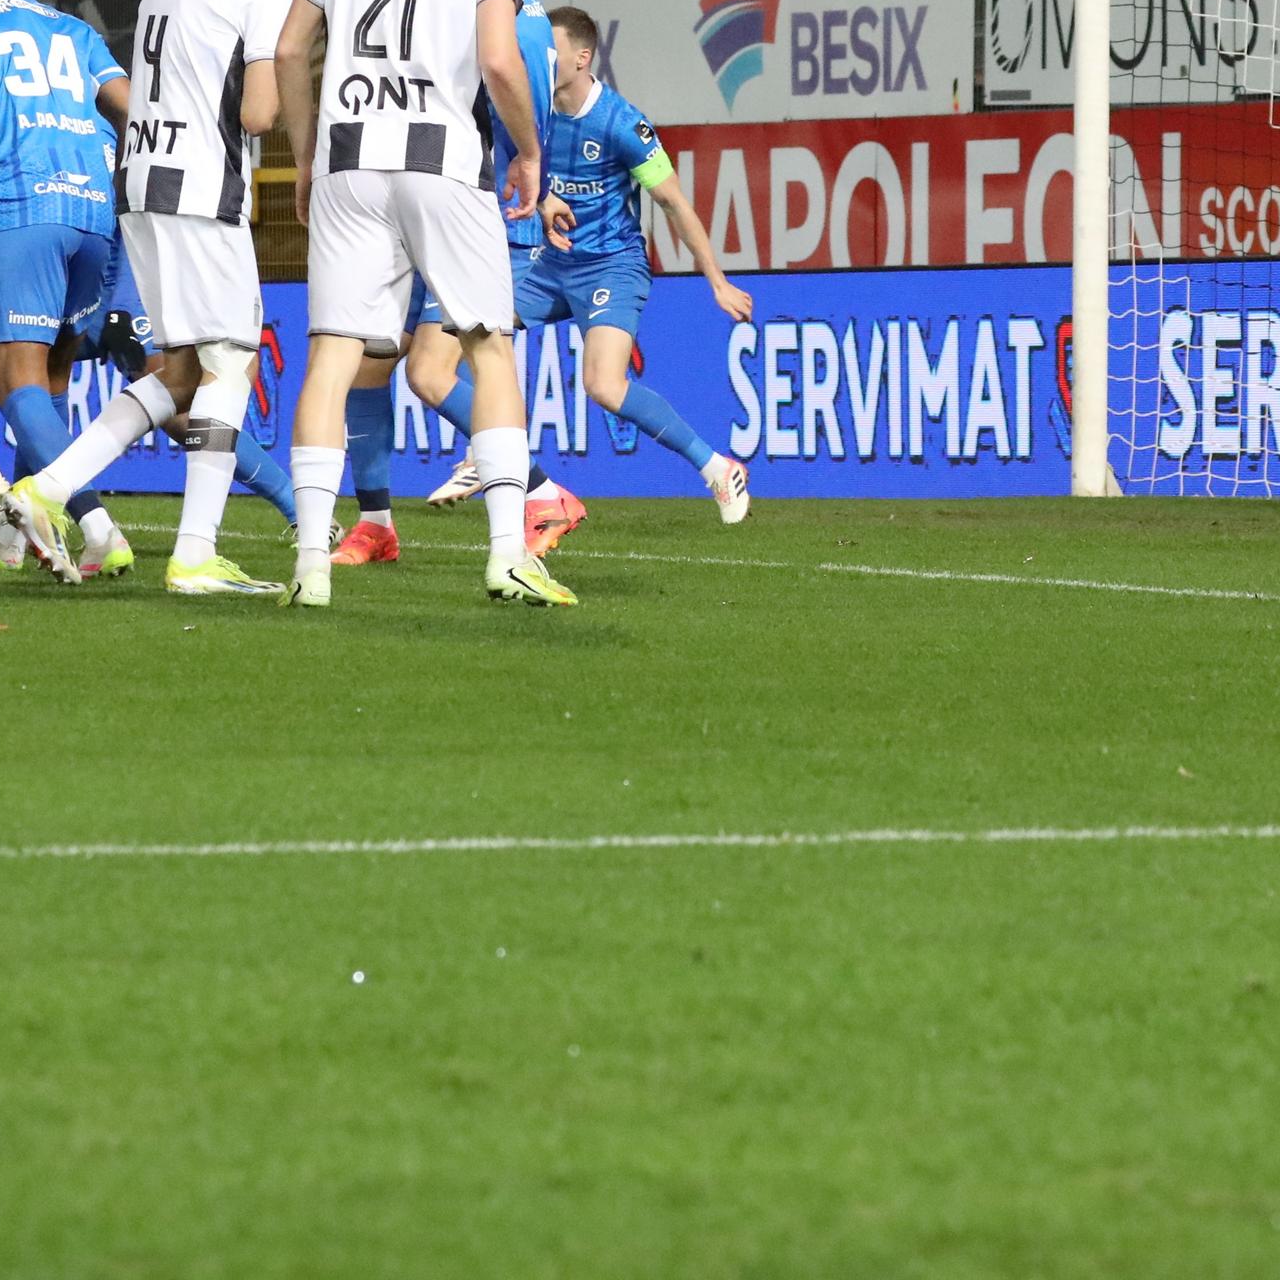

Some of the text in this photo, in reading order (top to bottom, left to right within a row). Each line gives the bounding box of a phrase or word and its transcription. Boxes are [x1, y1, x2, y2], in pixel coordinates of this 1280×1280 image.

[143, 15, 168, 102] 4
[790, 4, 928, 96] BESIX
[338, 74, 434, 116] QNT
[34, 182, 108, 204] CARGLASS
[109, 313, 119, 324] 3
[728, 316, 1043, 462] SERVIMAT
